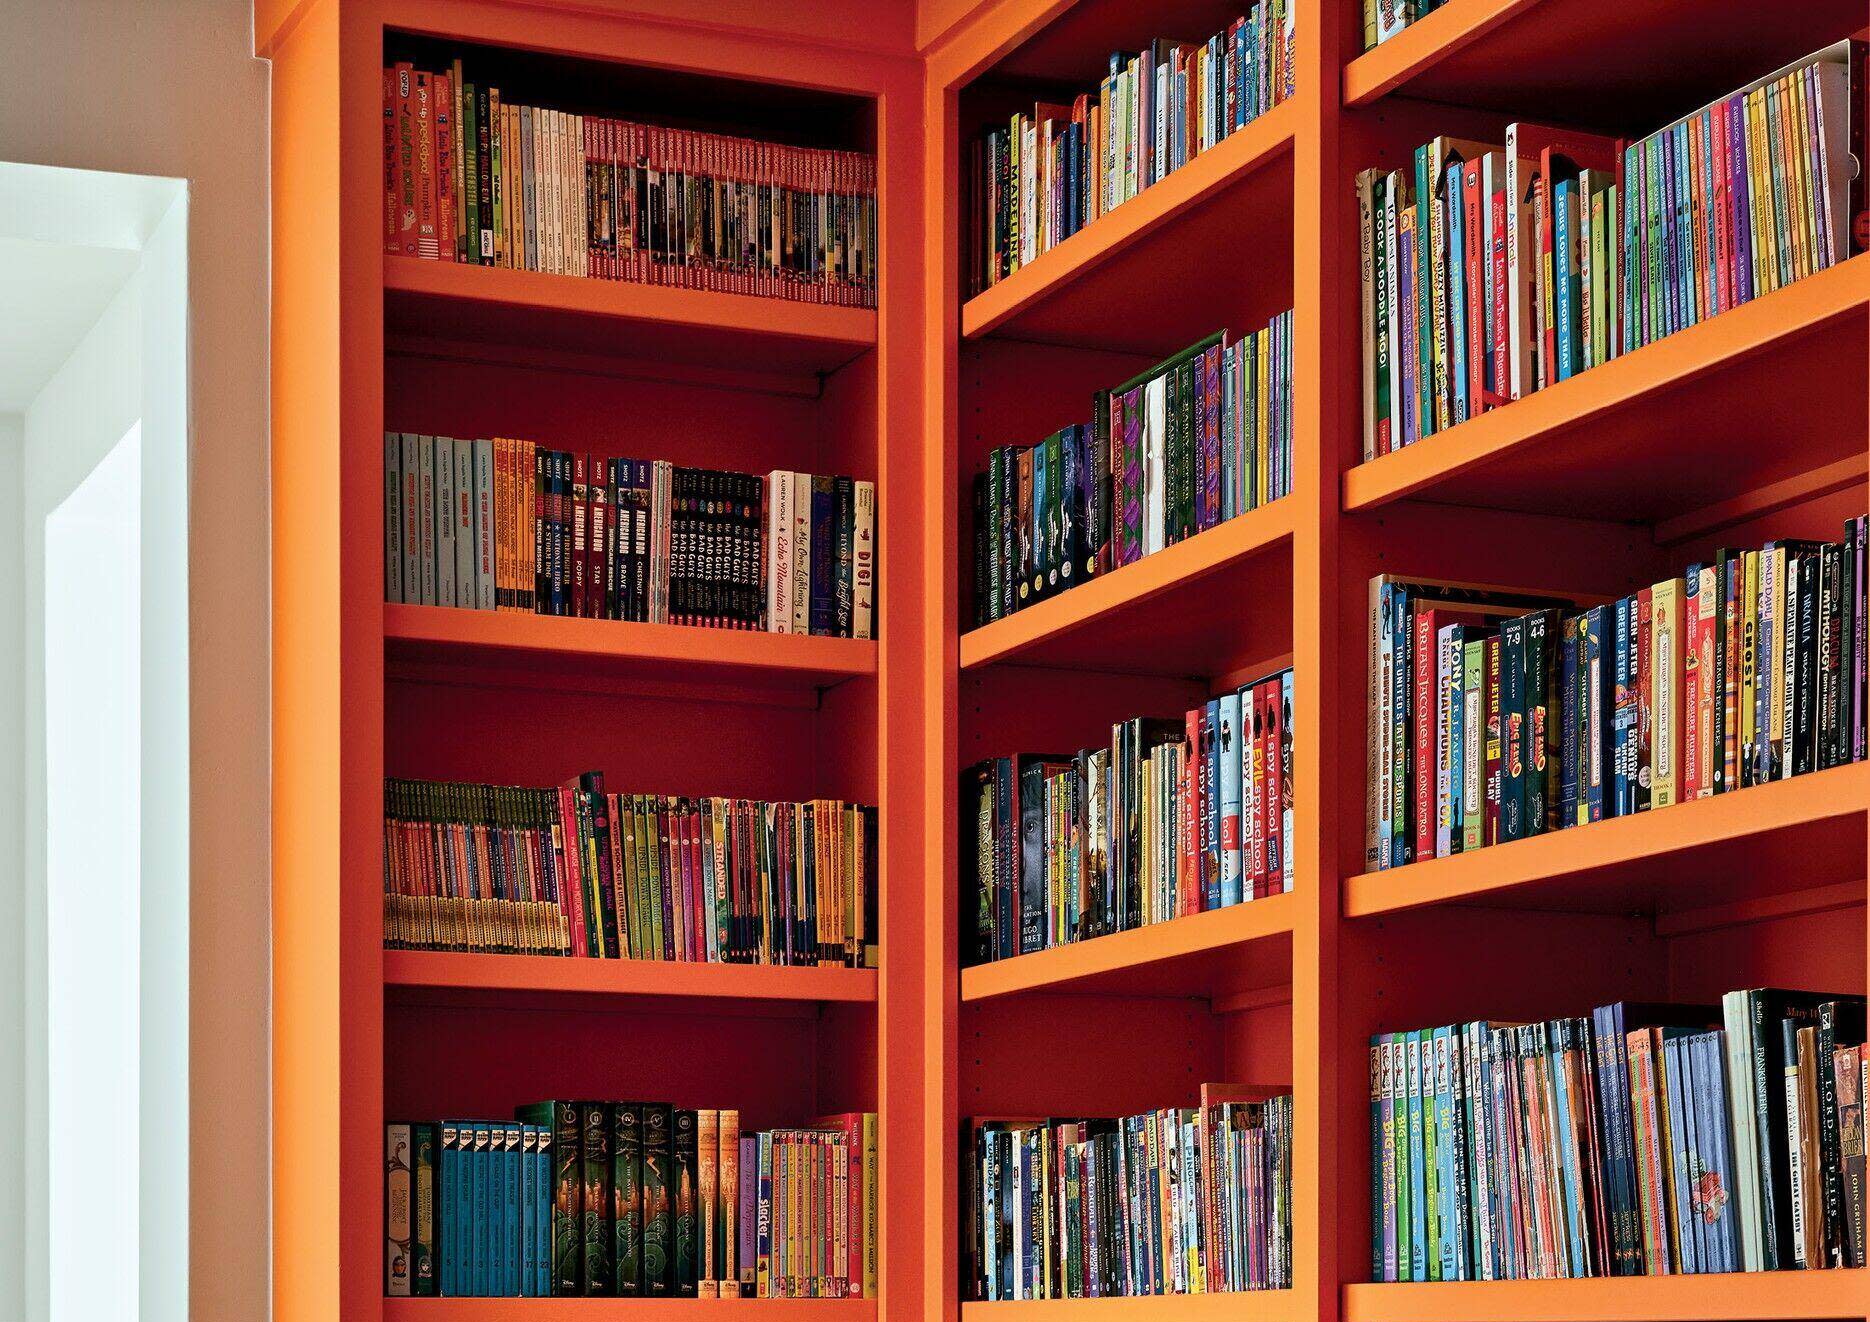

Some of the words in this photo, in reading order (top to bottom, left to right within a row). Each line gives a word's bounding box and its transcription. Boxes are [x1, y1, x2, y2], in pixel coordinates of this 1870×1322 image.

[1011, 165, 1019, 263] MADELINE
[779, 475, 787, 499] LAUREN
[858, 551, 871, 588] DIG!
[1765, 586, 1773, 617] DAHL
[1419, 621, 1429, 676] BRIAN
[1822, 590, 1830, 672] MYTHOLOGY
[1452, 639, 1461, 691] PONY
[1491, 642, 1499, 676] GREEN
[1744, 622, 1752, 688] GHOST
[1419, 680, 1429, 749] JACQUES
[1253, 748, 1263, 785] EVIL
[1267, 742, 1277, 772] spy
[1253, 785, 1263, 817] spy
[1268, 776, 1277, 833] school
[1419, 801, 1427, 839] PATROL
[716, 841, 726, 899] STRANDED
[1254, 821, 1263, 875] school
[1758, 1047, 1767, 1114] FRANKENSTEIN
[1851, 1174, 1859, 1200] JOHN
[758, 1199, 771, 1238] slacker
[1853, 1203, 1862, 1248] GRISHAM
